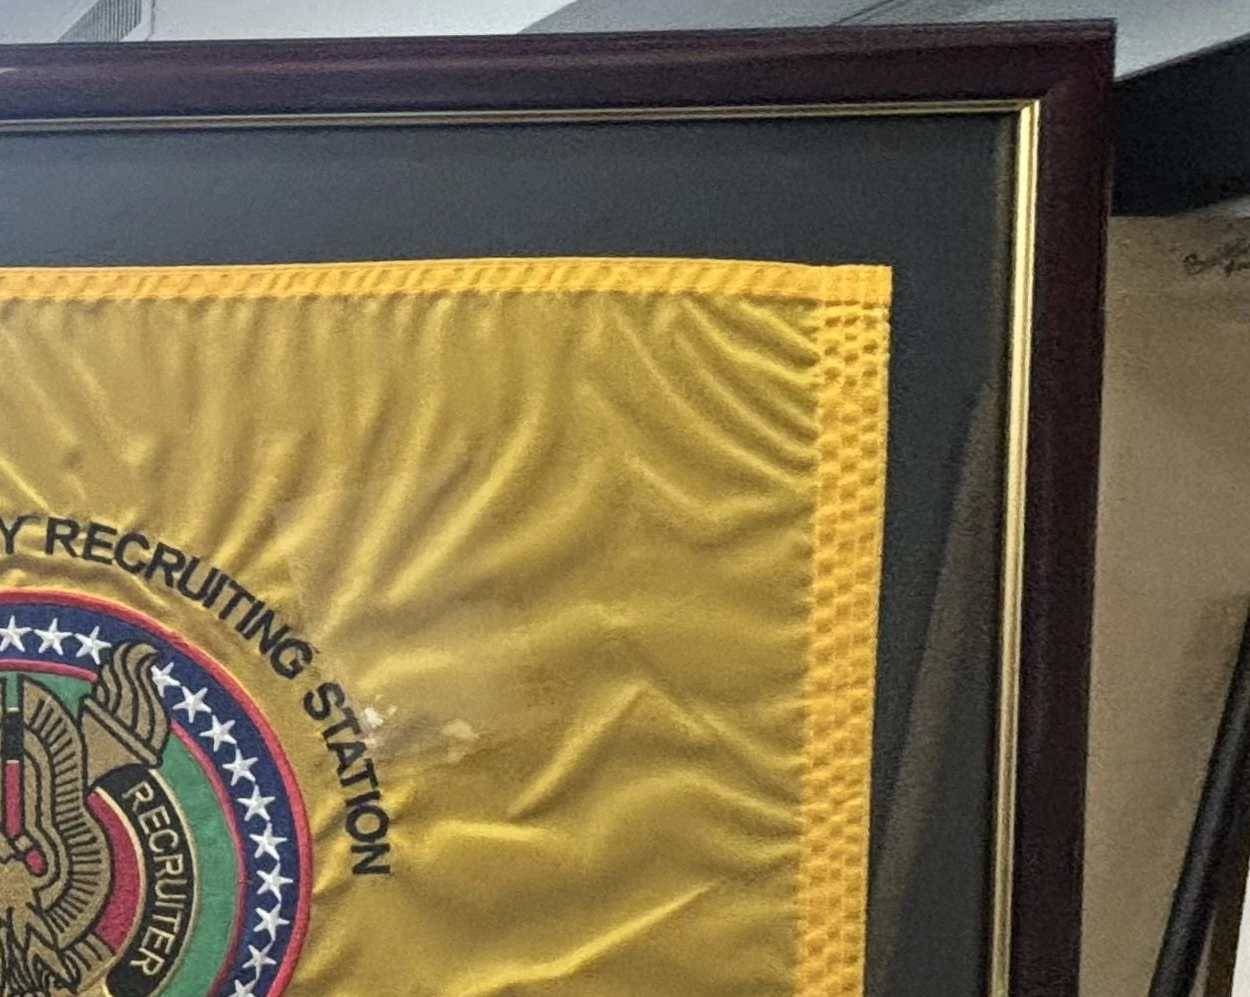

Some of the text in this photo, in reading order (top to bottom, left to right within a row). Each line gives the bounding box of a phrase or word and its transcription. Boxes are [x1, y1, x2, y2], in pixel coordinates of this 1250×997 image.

[44, 517, 311, 680] RECRUITING
[303, 681, 392, 876] STATION
[122, 780, 187, 976] RECRUITER
